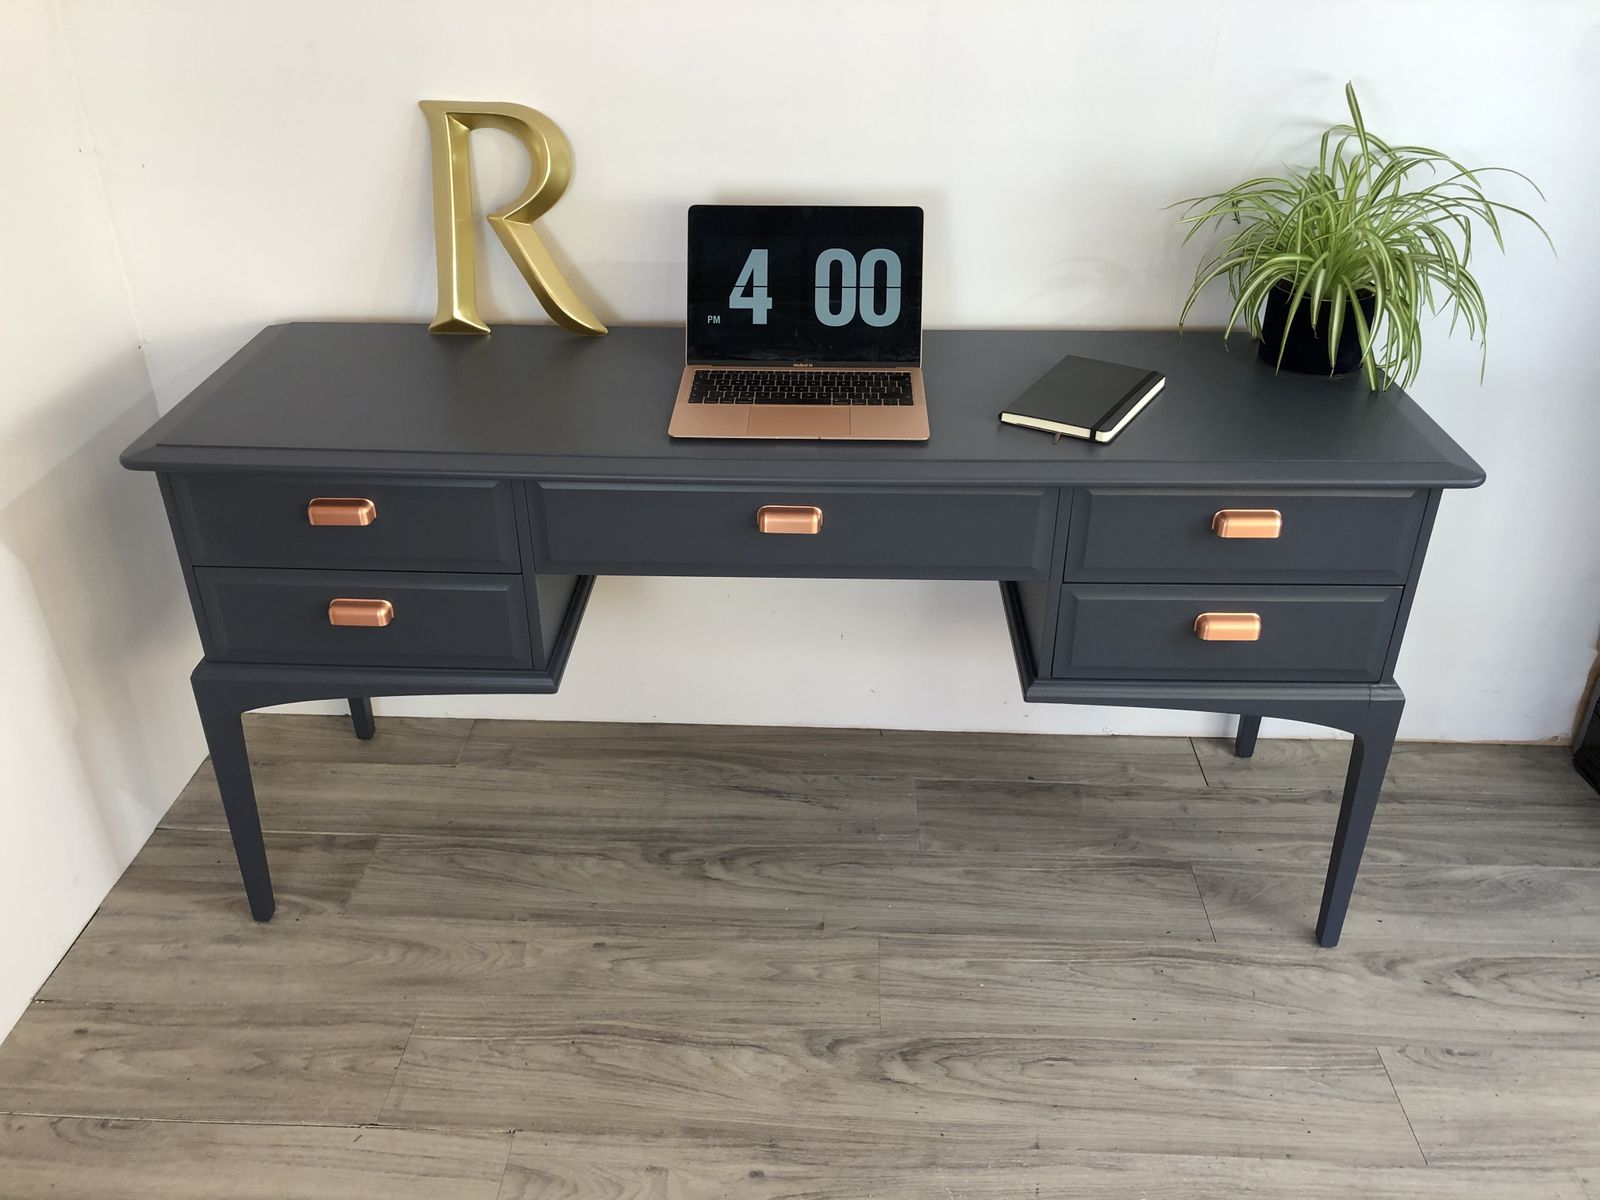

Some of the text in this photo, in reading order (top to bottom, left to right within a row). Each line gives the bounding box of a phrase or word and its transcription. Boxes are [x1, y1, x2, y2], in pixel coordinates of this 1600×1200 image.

[418, 100, 608, 337] R
[707, 315, 721, 324] PM
[728, 248, 902, 327] 4 00
